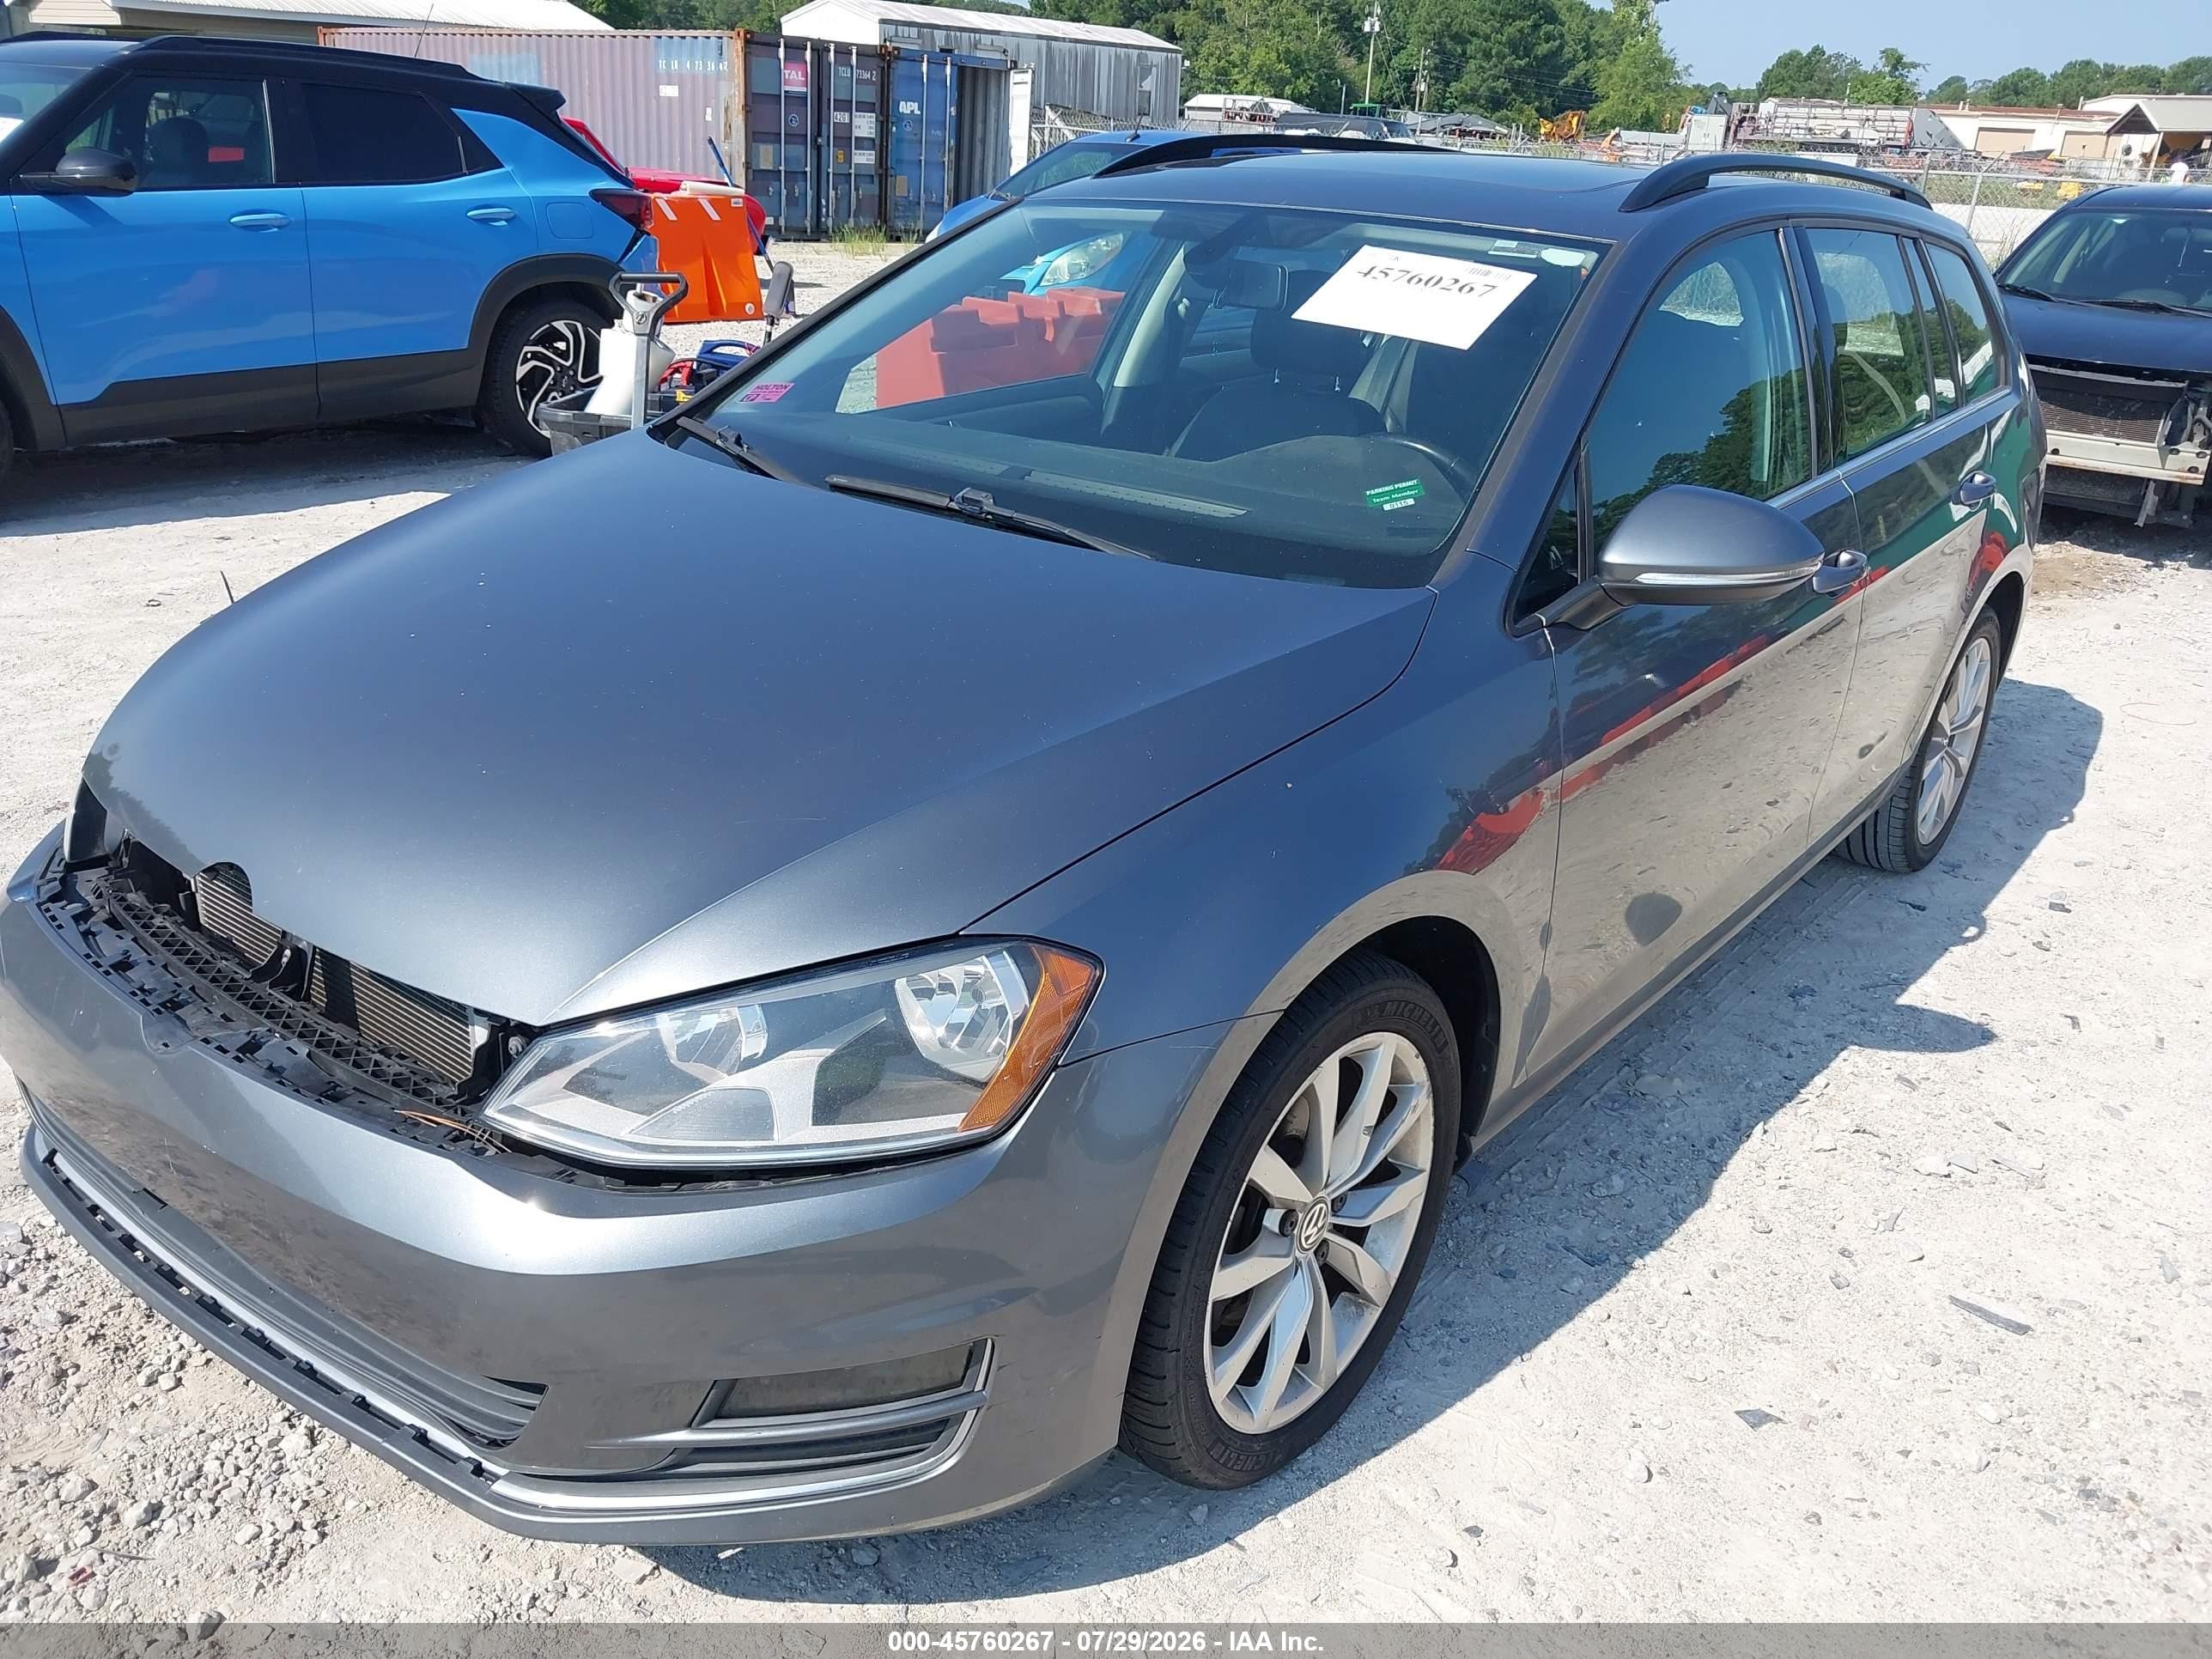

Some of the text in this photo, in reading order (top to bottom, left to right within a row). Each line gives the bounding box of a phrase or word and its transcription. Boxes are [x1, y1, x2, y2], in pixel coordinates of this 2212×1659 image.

[783, 70, 805, 81] TAL
[838, 66, 851, 77] TCLU
[899, 100, 921, 115] APL
[1357, 265, 1498, 297] 45760267
[1366, 479, 1419, 495] PARKING PERMIT
[1391, 489, 1419, 498] Member
[1382, 1000, 1446, 1048] MICHELIN
